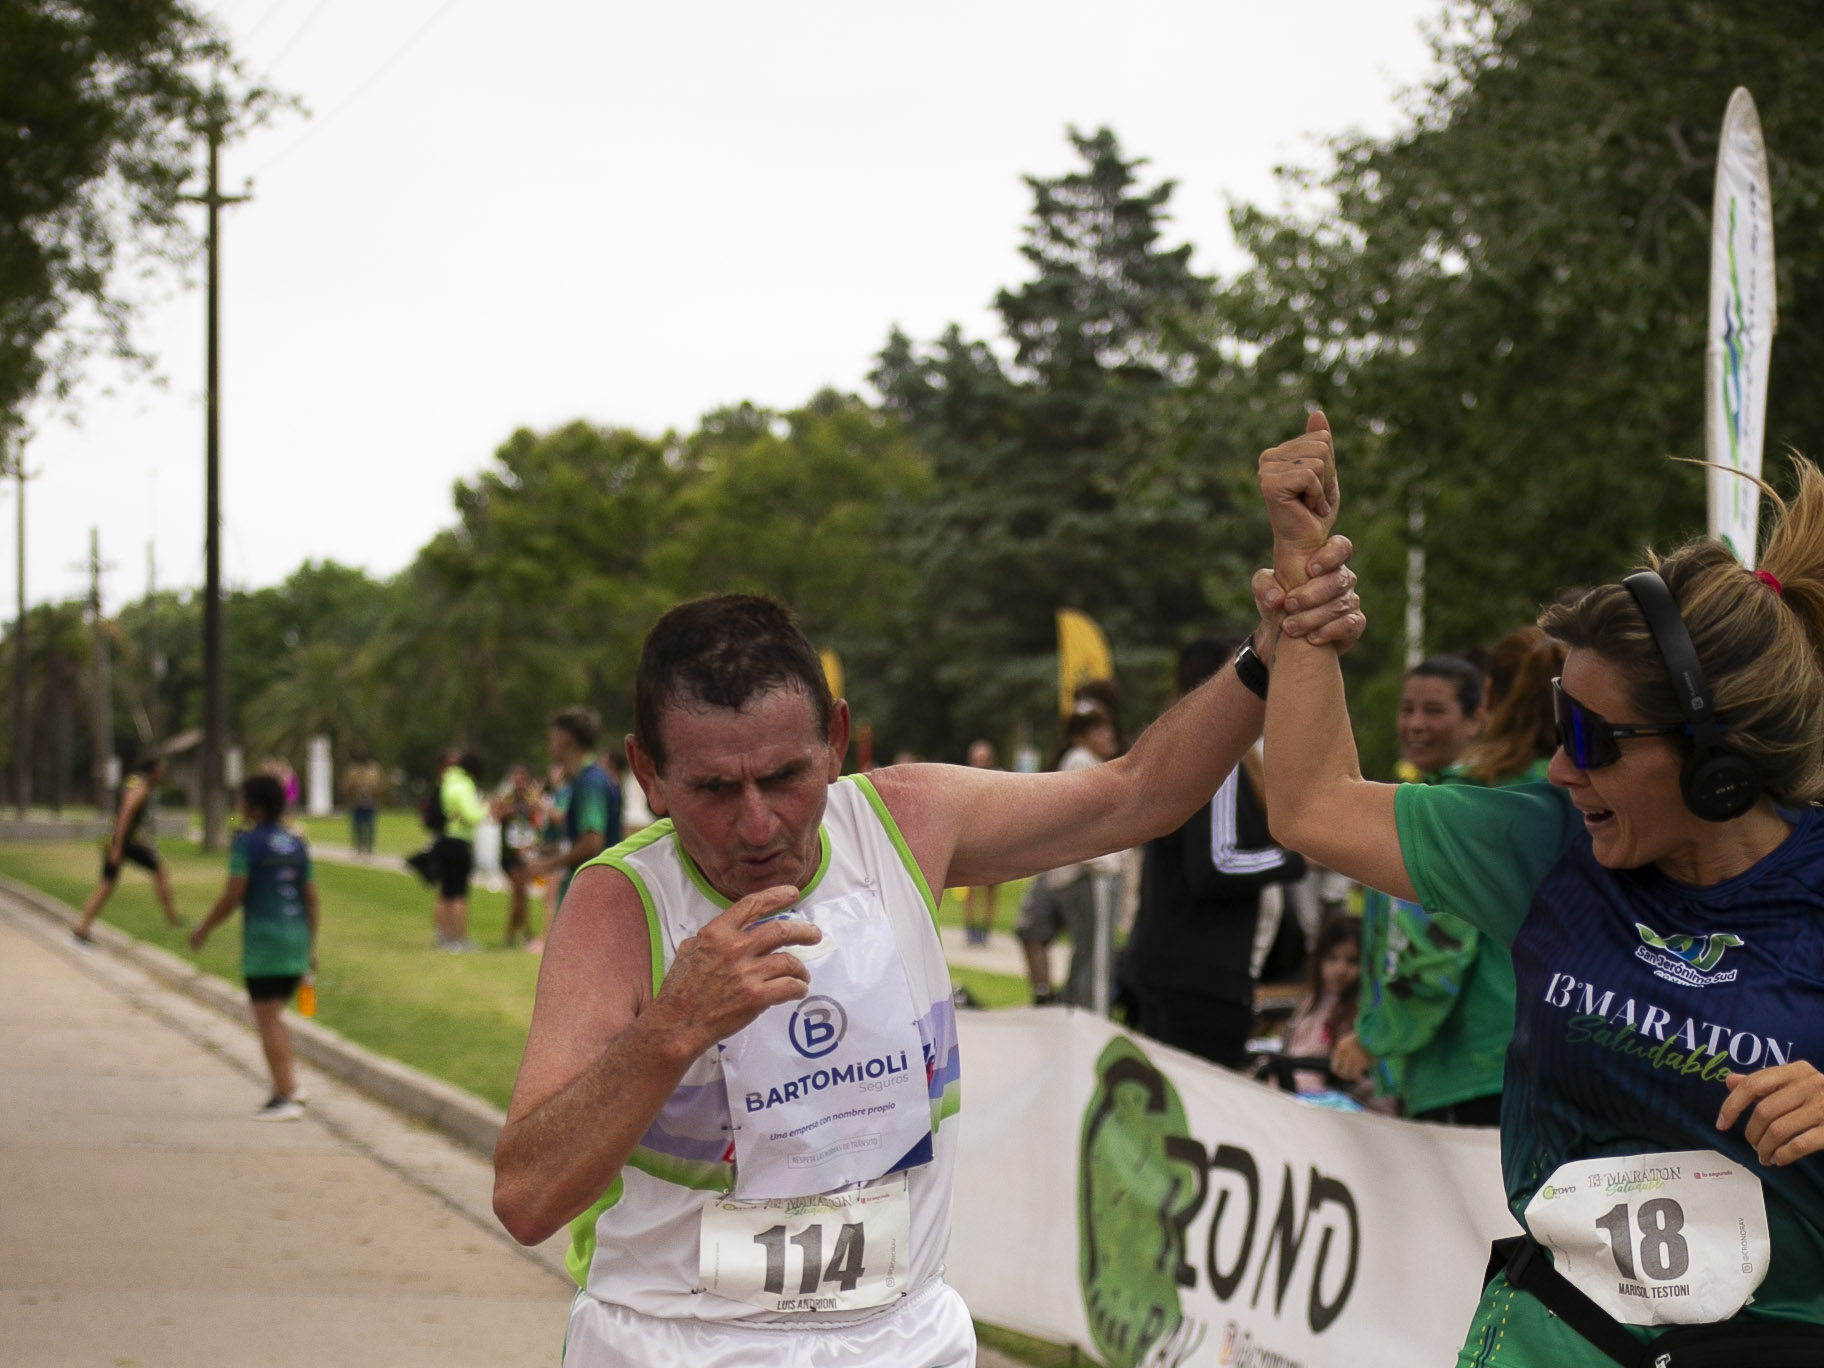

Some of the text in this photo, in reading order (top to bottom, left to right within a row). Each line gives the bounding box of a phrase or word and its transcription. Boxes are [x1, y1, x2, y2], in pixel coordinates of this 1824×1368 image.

[1635, 945, 1658, 967] San
[1656, 954, 1713, 985] Jerónimo
[1564, 1013, 1734, 1083] Saludable
[858, 1072, 910, 1094] Seguros
[769, 1101, 897, 1142] Una empresa con nombre propio
[1604, 1166, 1682, 1187] MARATON
[753, 1221, 866, 1296] 114
[1595, 1197, 1690, 1282] 18
[776, 1299, 796, 1312] LUIS
[1618, 1281, 1690, 1299] MARISOL TESTONI
